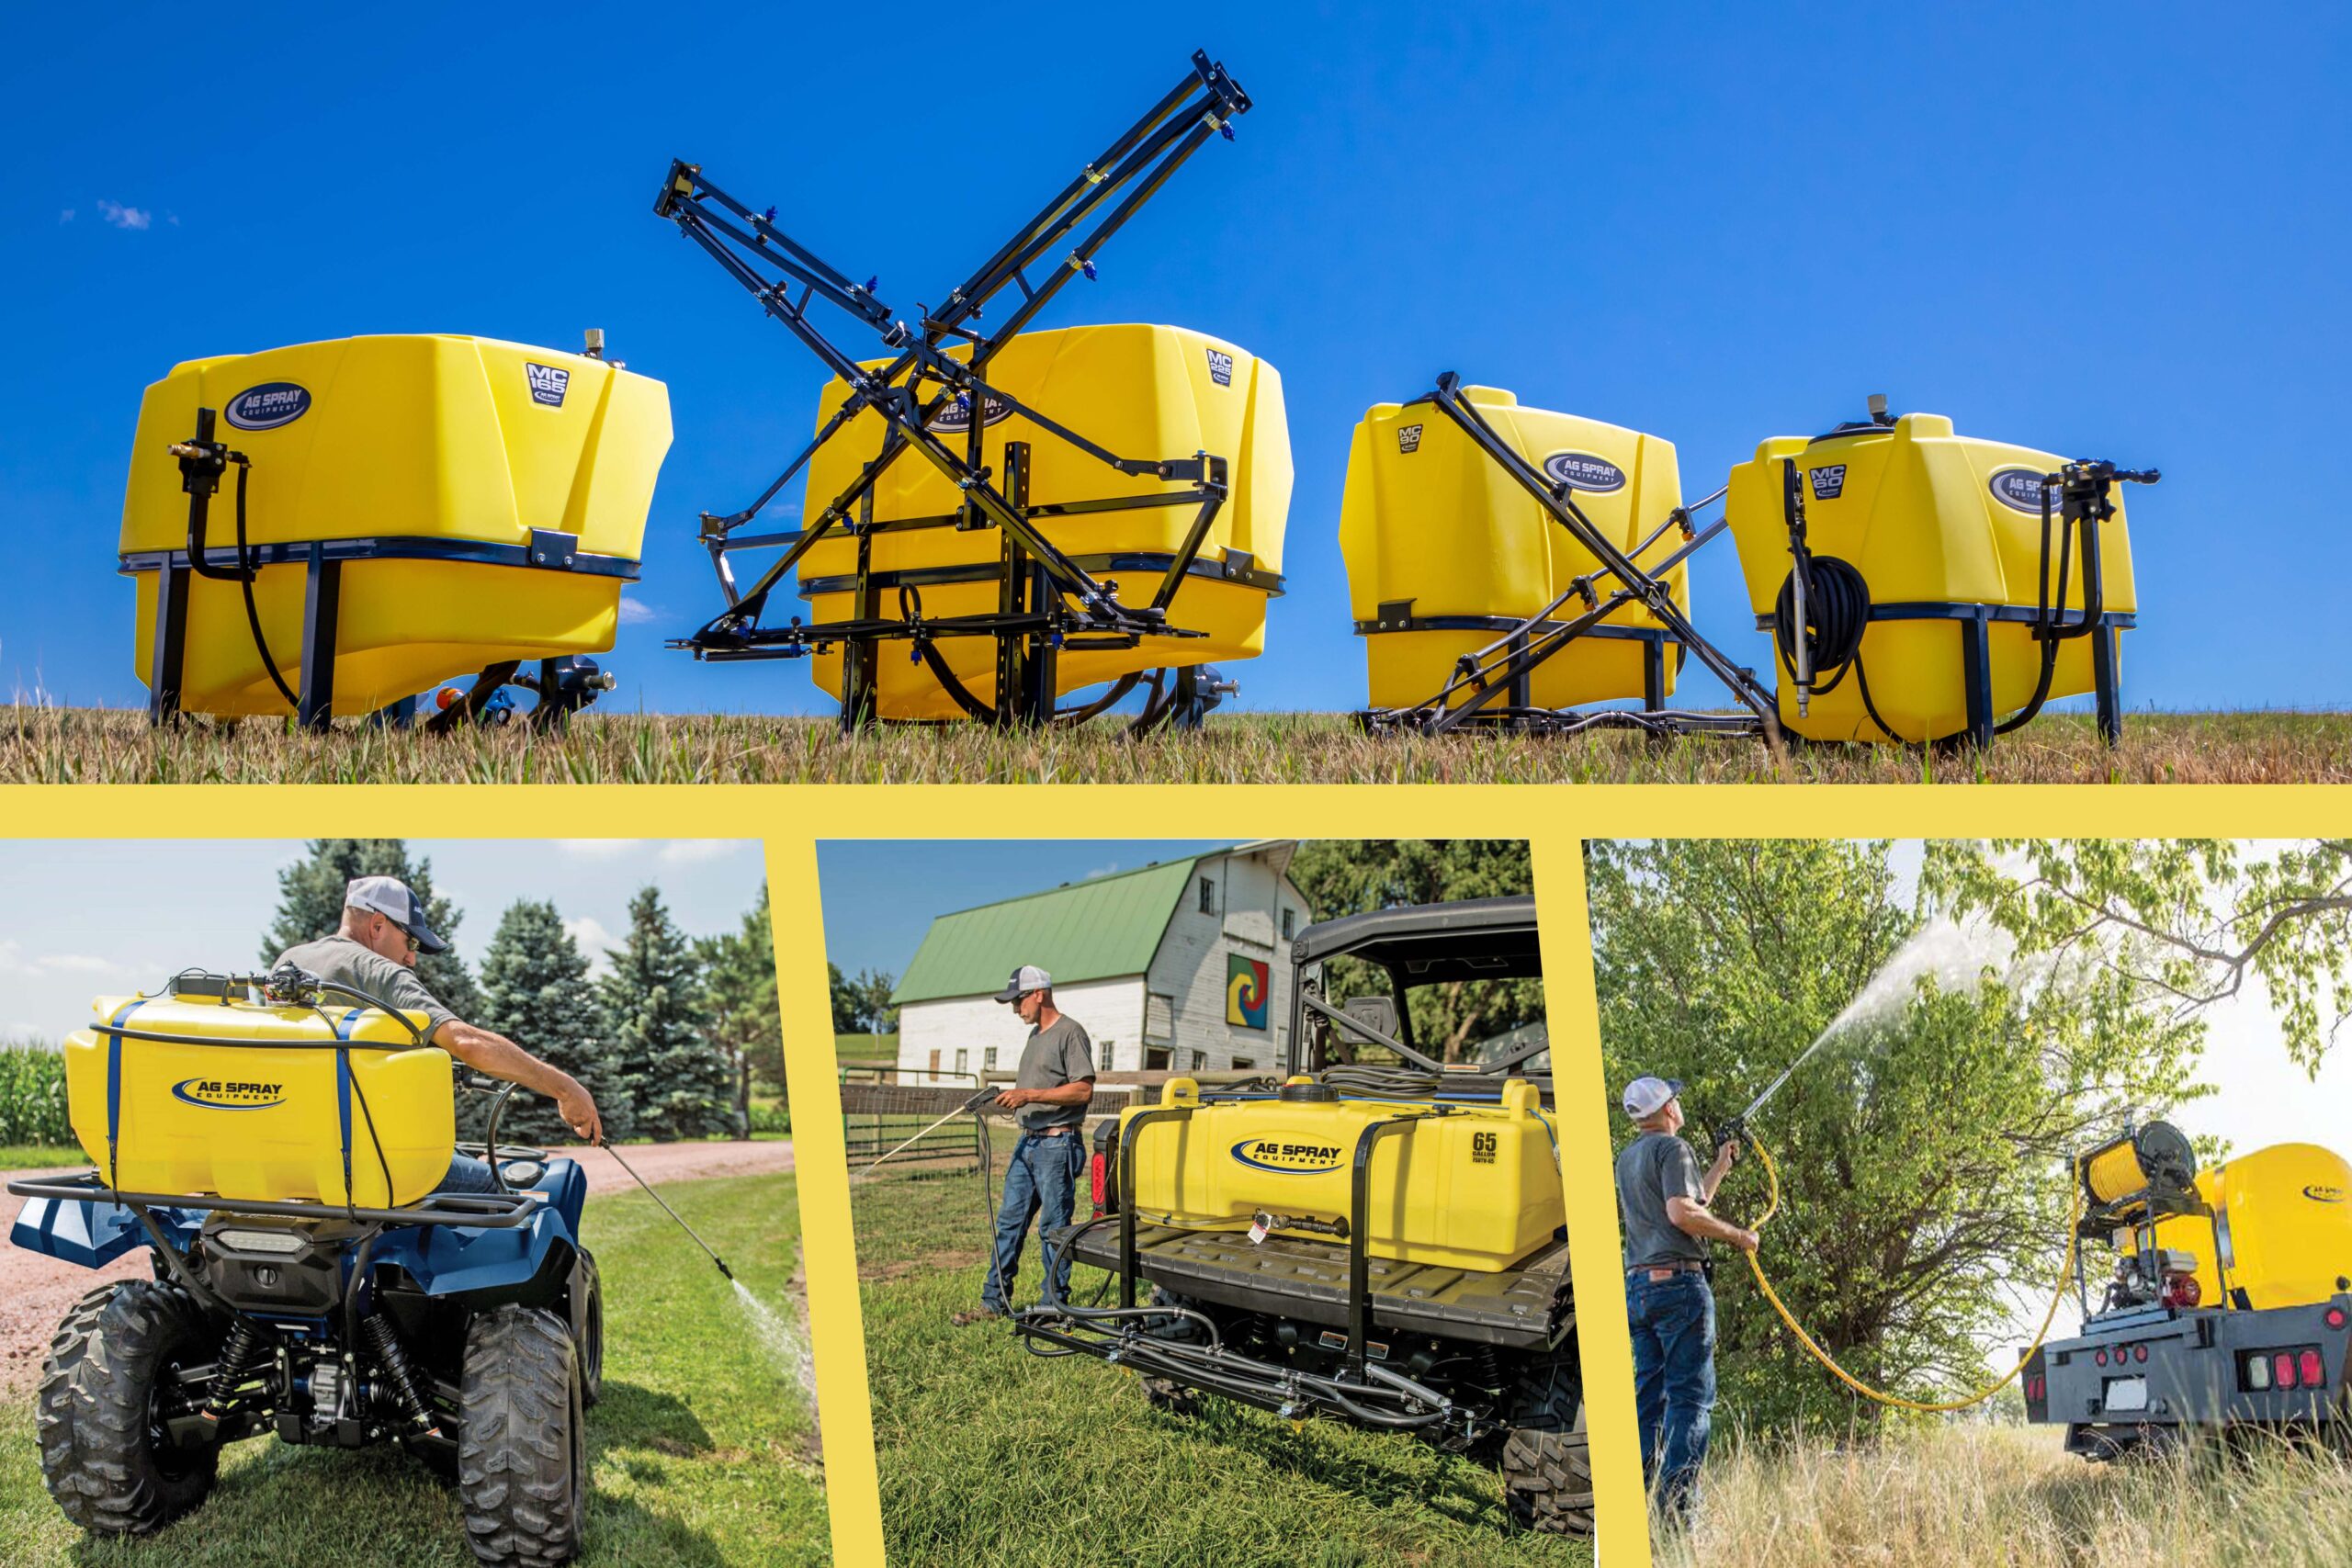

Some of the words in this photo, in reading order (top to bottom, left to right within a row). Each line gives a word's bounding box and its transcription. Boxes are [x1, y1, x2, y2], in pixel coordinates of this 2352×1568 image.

[1206, 349, 1232, 368] MC
[527, 364, 568, 383] MC
[1210, 362, 1231, 376] 225
[530, 377, 566, 393] 165
[244, 395, 262, 409] AG
[262, 389, 302, 406] SPRAY
[243, 404, 297, 416] EQUIPMENT
[939, 407, 1001, 422] EQUIPNT
[941, 402, 958, 415] AG
[1398, 425, 1421, 437] MC
[1400, 434, 1420, 445] 90
[1565, 460, 1580, 471] AG
[1581, 462, 1617, 477] SPRAY
[1810, 466, 1845, 479] MC
[1564, 469, 1614, 483] EQUIPMENT
[1813, 476, 1843, 489] 60
[2009, 478, 2024, 491] AG
[198, 1081, 222, 1092] AG
[225, 1082, 283, 1094] SPRAY
[197, 1092, 278, 1100] EQUIPMENT
[1473, 1132, 1497, 1152] 65
[1255, 1143, 1279, 1155] AG
[1282, 1145, 1341, 1158] SPRAY
[1253, 1154, 1336, 1166] EQUIPMENT
